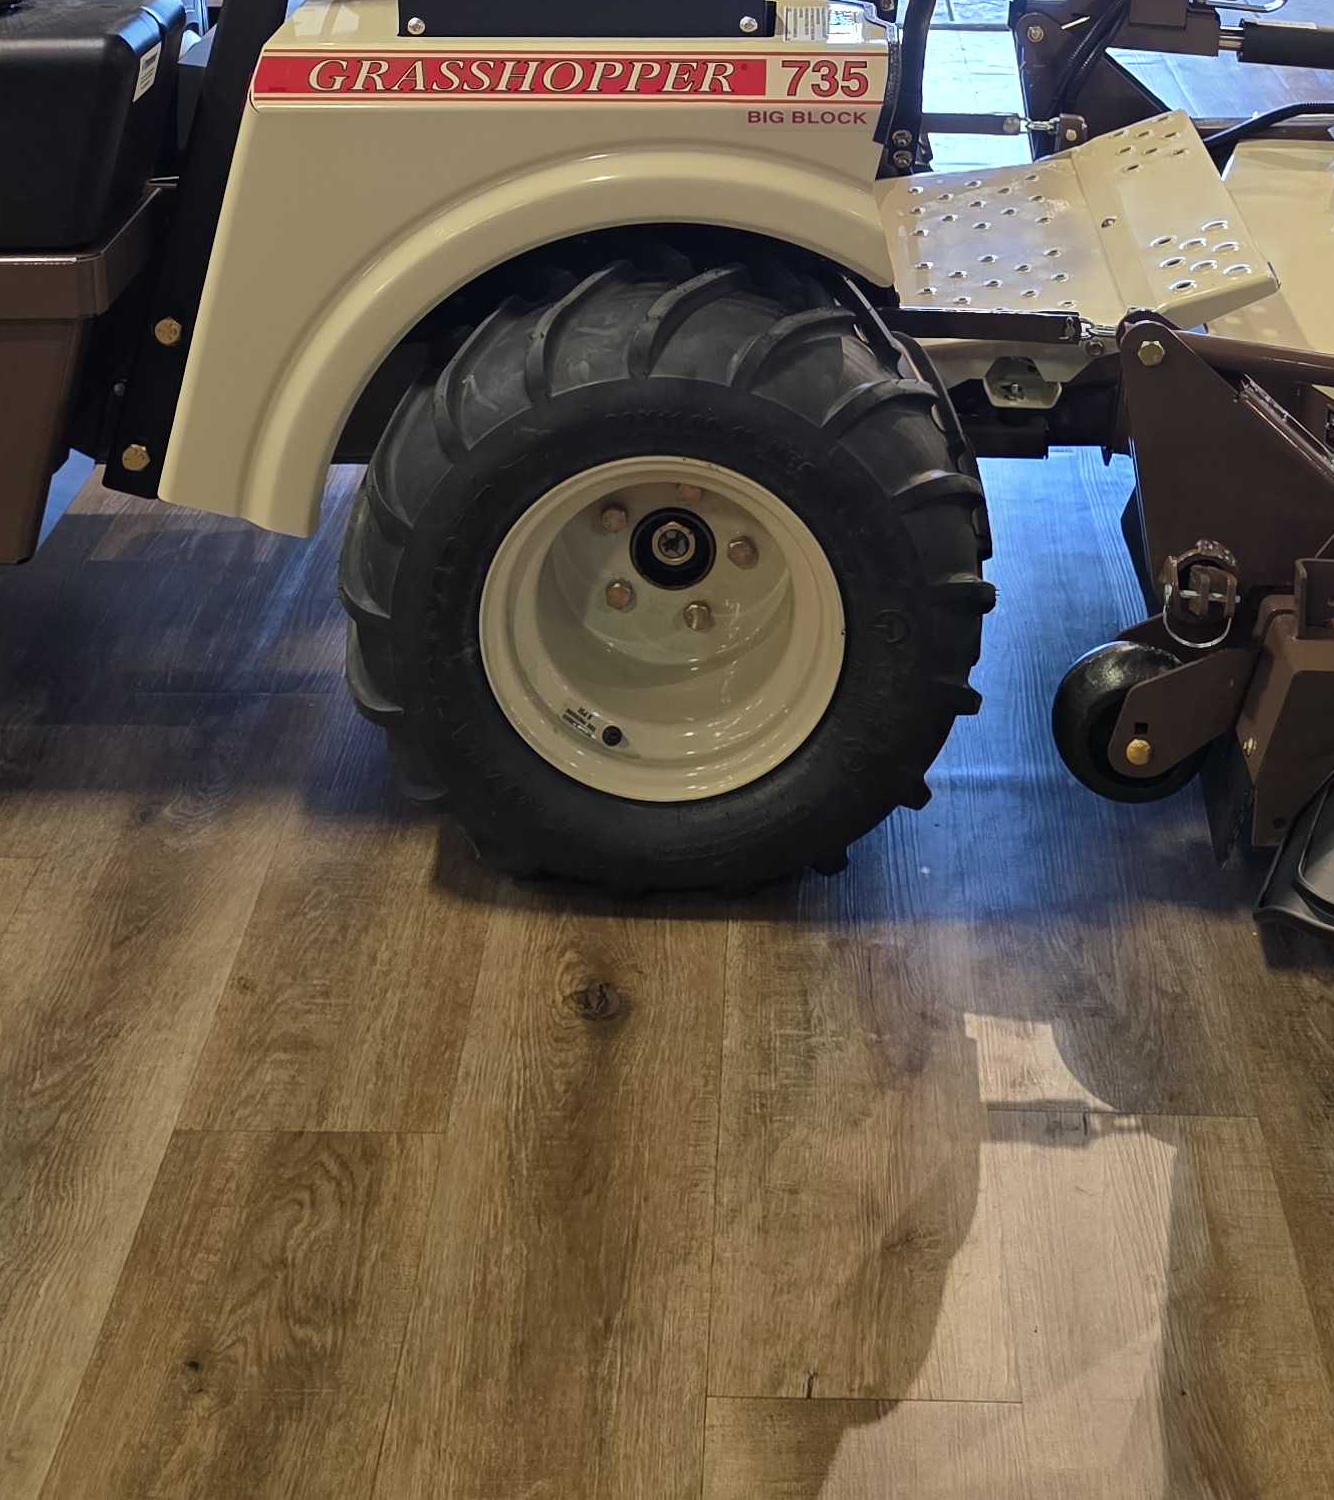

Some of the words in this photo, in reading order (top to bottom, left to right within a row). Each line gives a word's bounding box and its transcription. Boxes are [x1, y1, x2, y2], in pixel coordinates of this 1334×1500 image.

[307, 59, 736, 94] GRASSHOPPER
[781, 59, 870, 98] 735
[747, 110, 785, 124] BIG
[791, 111, 868, 125] BLOCK
